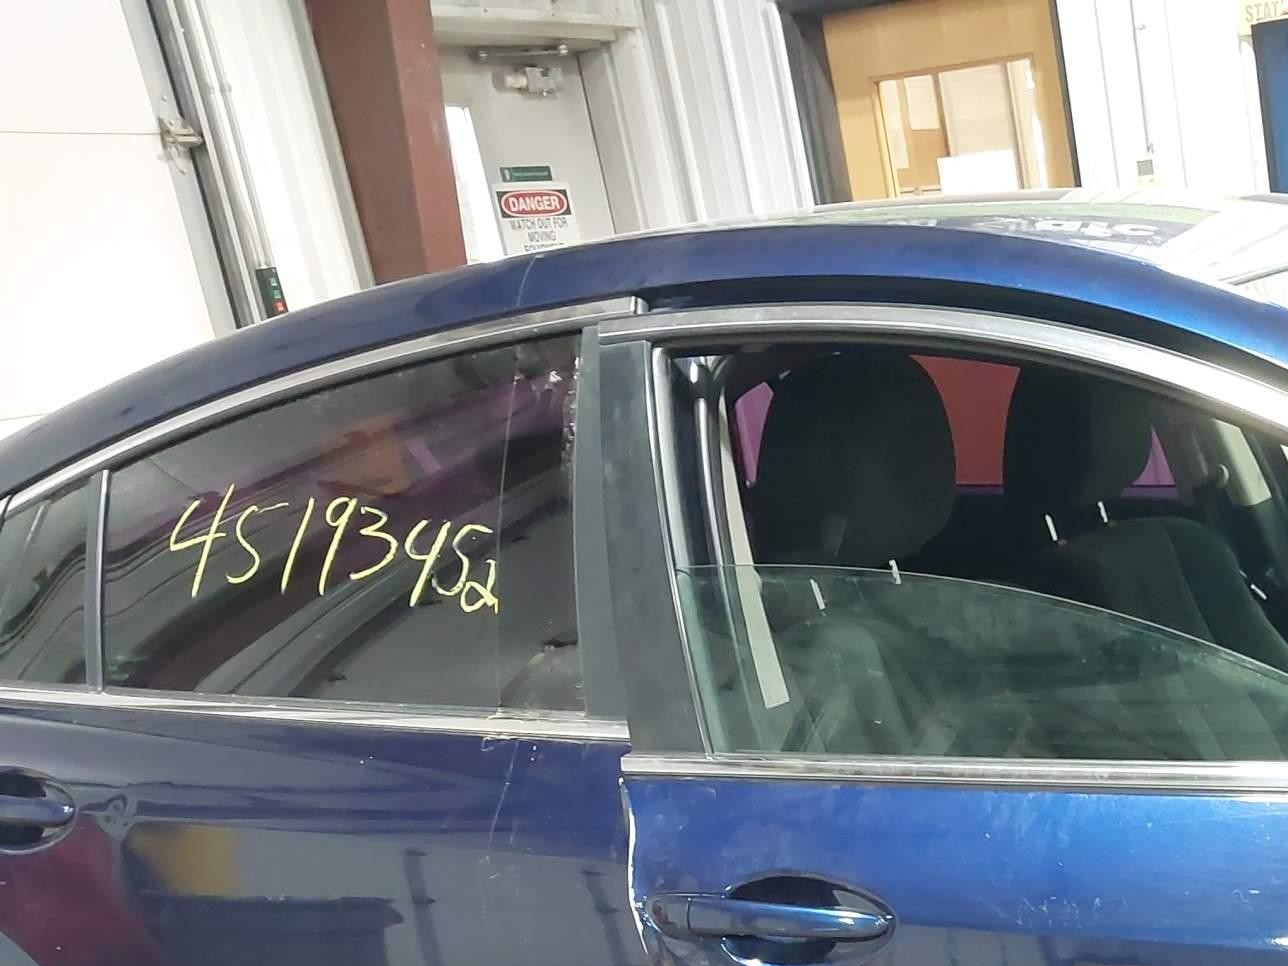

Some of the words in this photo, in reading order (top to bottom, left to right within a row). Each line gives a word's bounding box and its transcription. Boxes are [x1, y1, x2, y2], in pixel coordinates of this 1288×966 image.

[508, 195, 560, 211] DANGER
[509, 218, 537, 230] WATCH
[537, 217, 551, 229] OUT
[553, 216, 568, 228] FOR
[527, 230, 557, 242] MOVING
